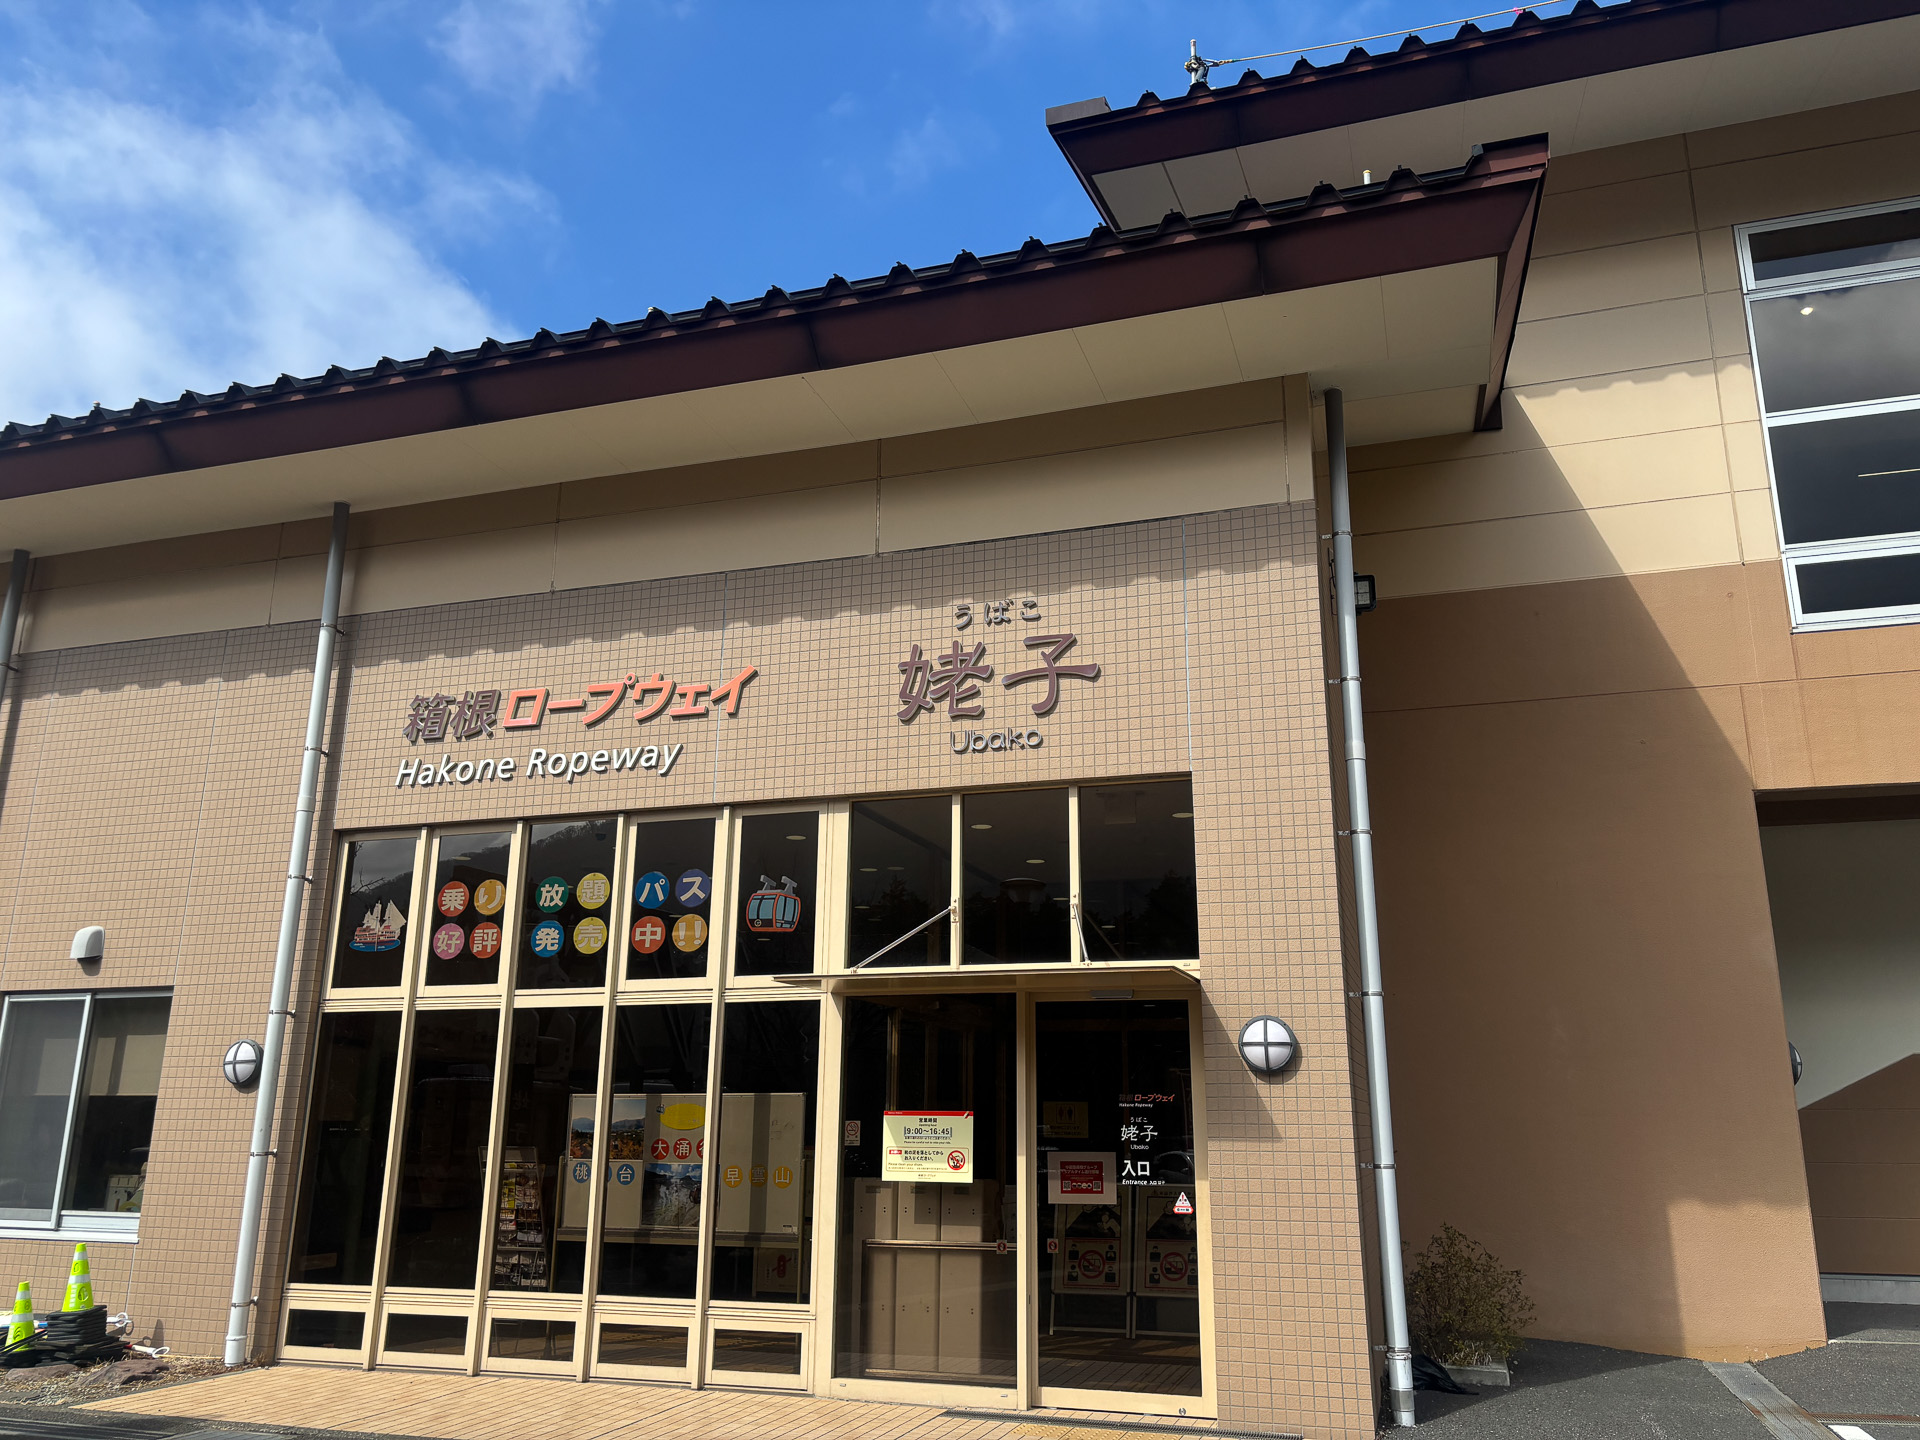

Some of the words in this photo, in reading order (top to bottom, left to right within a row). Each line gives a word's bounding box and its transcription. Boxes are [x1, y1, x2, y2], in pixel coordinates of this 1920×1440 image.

[954, 599, 1042, 630] うばこ
[897, 633, 1100, 721] 姥子
[402, 665, 758, 742] 箱根ロープウェイ
[951, 726, 1043, 753] Ubako
[394, 753, 516, 788] Hakone
[526, 743, 684, 783] Ropeway
[1120, 1124, 1158, 1142] 姥子
[726, 1166, 790, 1186] 早雲山
[1121, 1160, 1150, 1177] 入口
